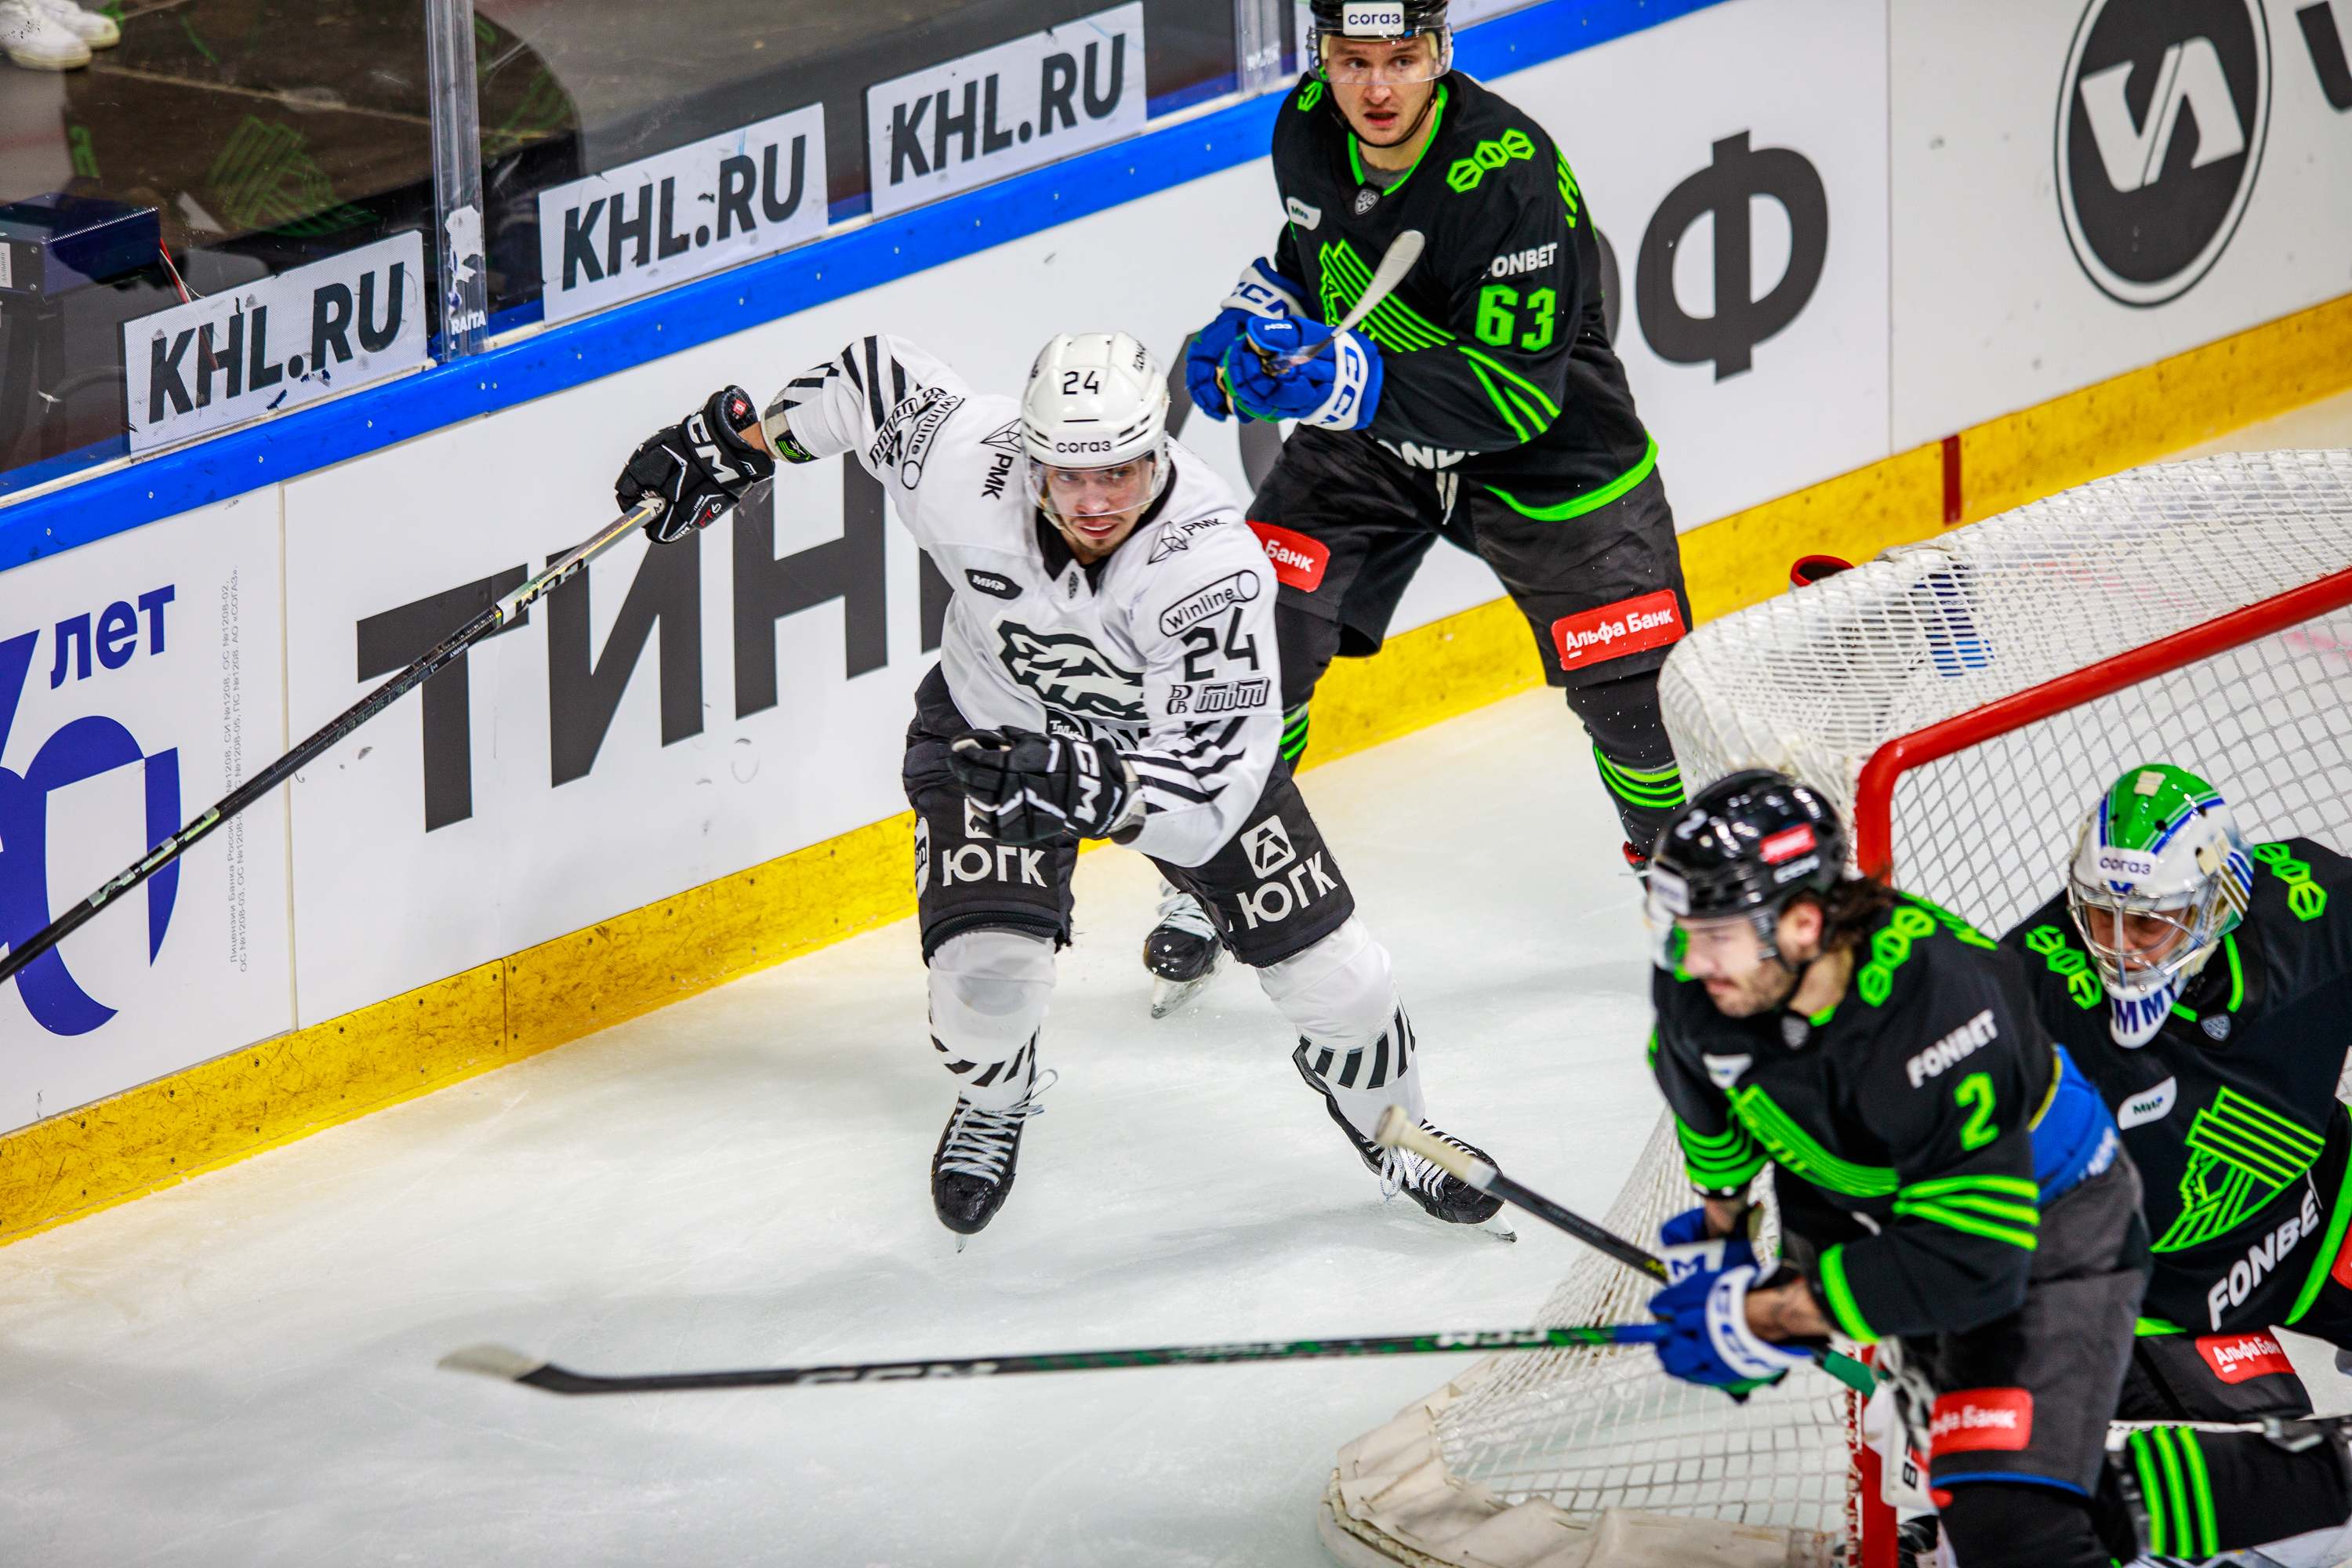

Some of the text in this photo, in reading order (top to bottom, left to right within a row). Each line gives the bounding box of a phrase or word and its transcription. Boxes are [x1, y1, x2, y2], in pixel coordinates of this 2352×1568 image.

[1348, 13, 1401, 25] согаз
[888, 33, 1127, 187] KHL.RU
[561, 135, 806, 292] KHL.RU
[1481, 241, 1558, 279] ONBET
[452, 310, 486, 336] RAITA
[1475, 284, 1556, 352] 63
[149, 262, 405, 425] KHL.RU
[1062, 371, 1099, 395] 24
[1056, 441, 1112, 453] согаз
[981, 452, 1014, 500] РМК
[1265, 539, 1314, 572] Банк
[972, 575, 1007, 591] МИР
[51, 584, 175, 690] лет
[231, 625, 239, 644] АО
[1181, 607, 1259, 682] 24
[1566, 608, 1675, 652] Альфа Банк
[222, 650, 230, 670] ОС
[233, 694, 241, 712] ПС
[223, 724, 231, 743] СИ
[227, 864, 237, 902] Банка
[236, 866, 245, 885] ОС
[942, 844, 1047, 887] ЮГК
[1236, 851, 1338, 930] ЮГК
[230, 904, 238, 963] Лицензии
[238, 953, 247, 972] ОС
[1906, 1009, 1998, 1089] FONBET
[1953, 1072, 1999, 1151] 2
[2208, 1184, 2322, 1332] FONBE
